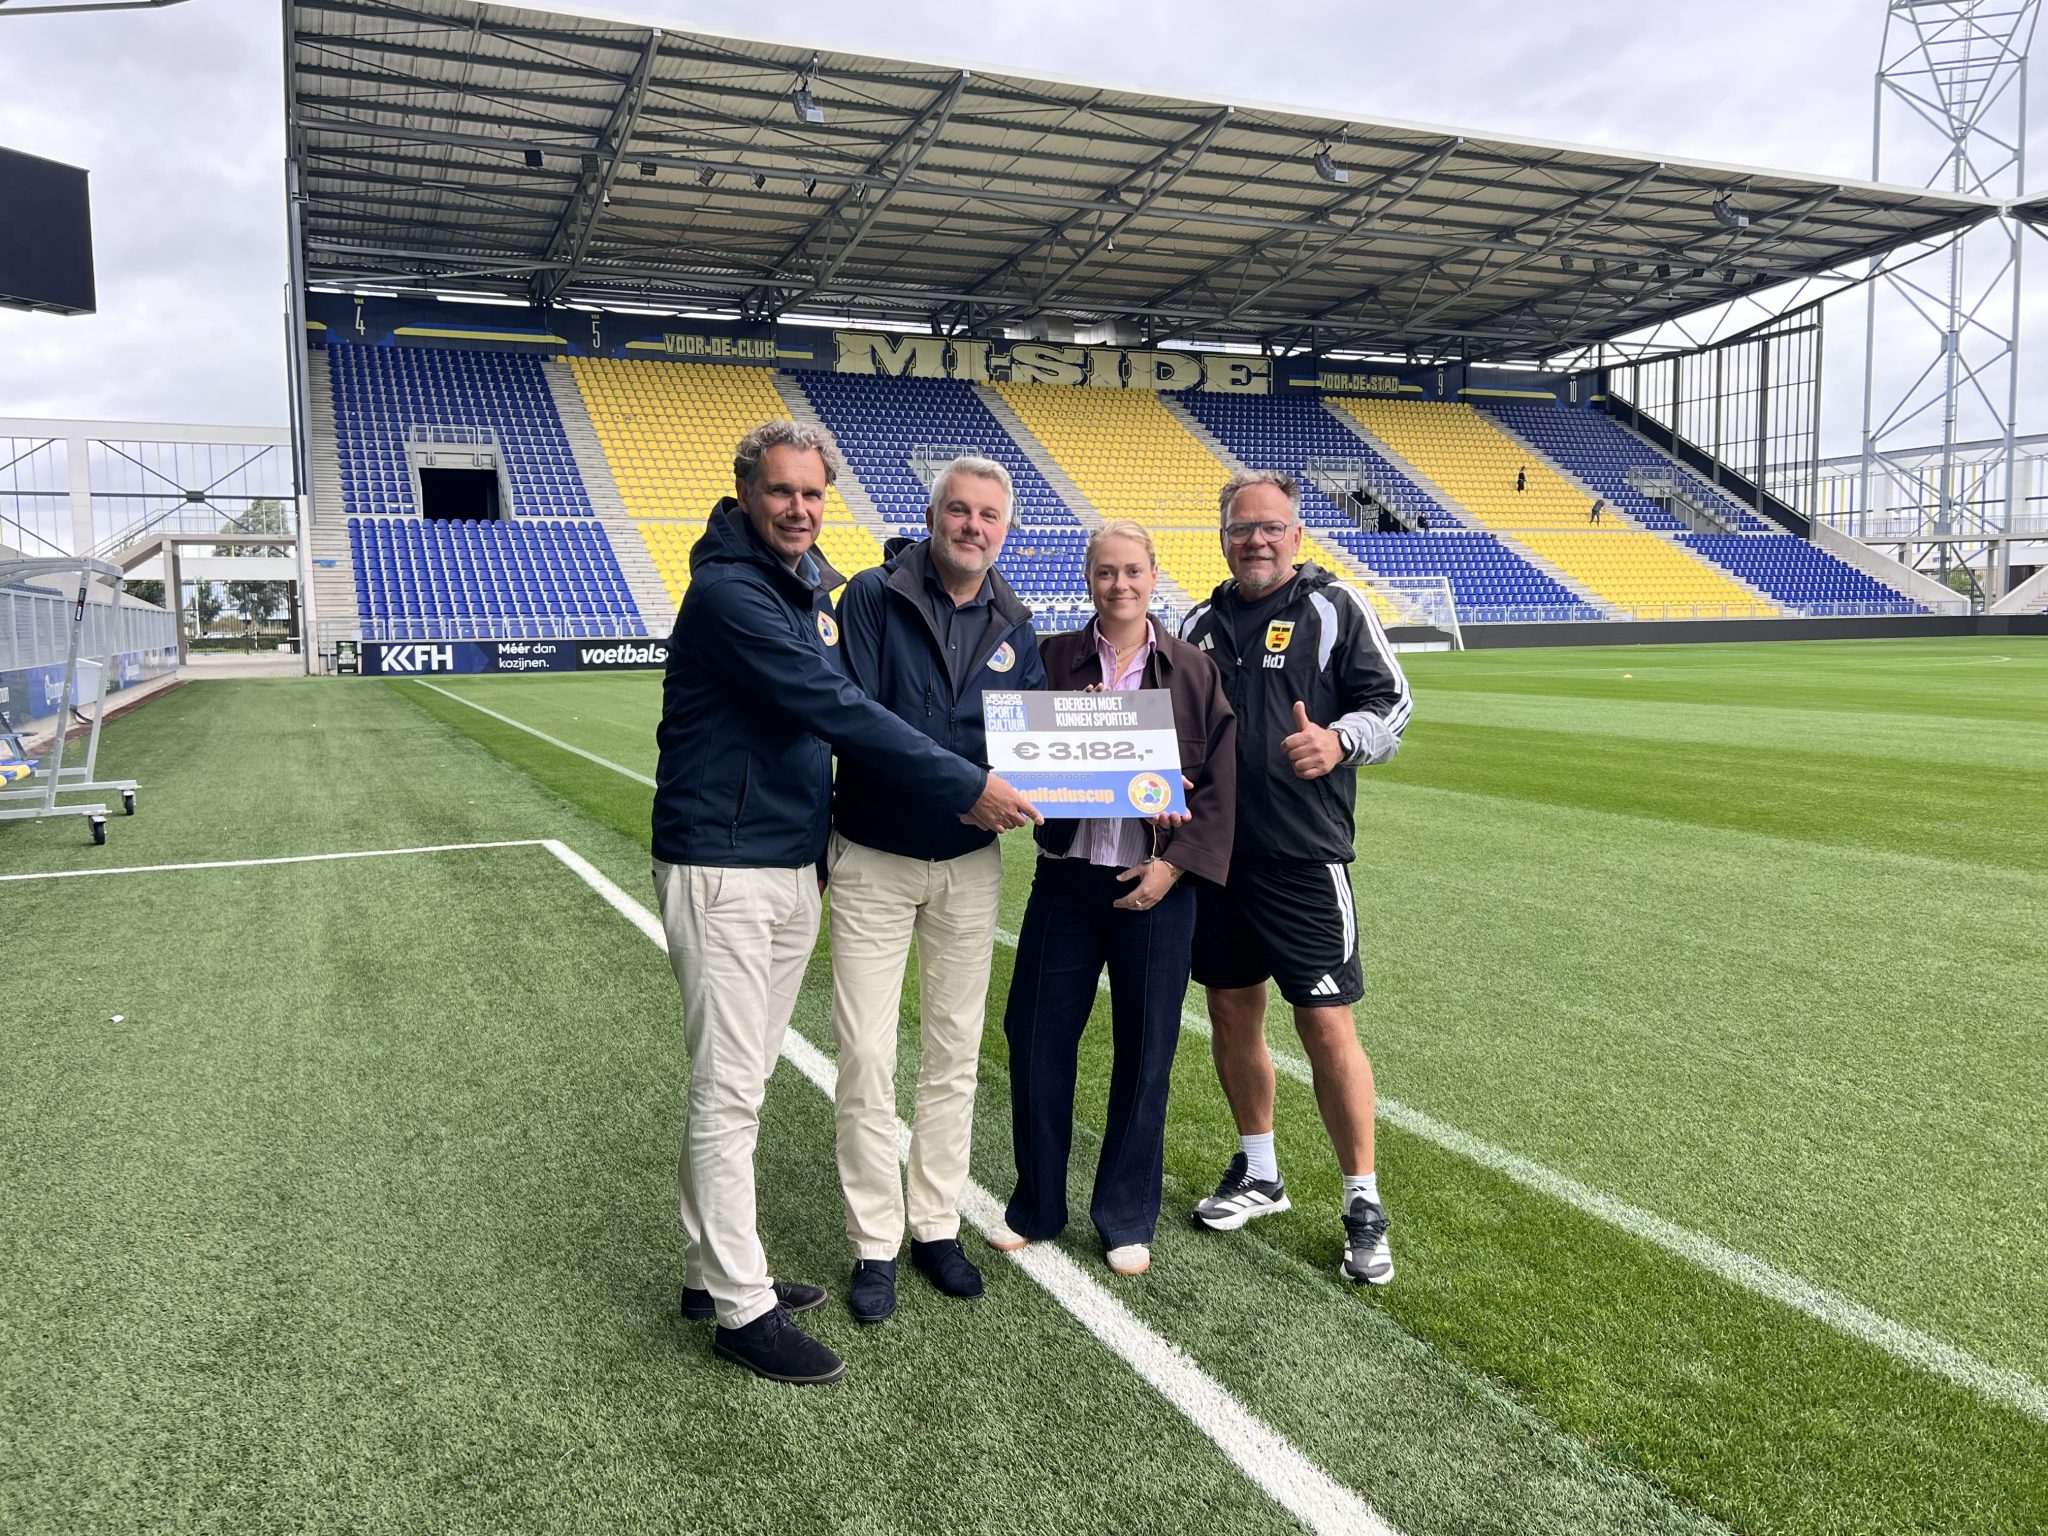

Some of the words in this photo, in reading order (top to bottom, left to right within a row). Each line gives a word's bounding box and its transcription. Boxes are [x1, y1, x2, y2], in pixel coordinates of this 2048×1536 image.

[356, 306, 365, 335] 4
[592, 321, 600, 348] 5
[833, 331, 1273, 395] MI-SIDE
[1438, 374, 1443, 395] 9
[1569, 381, 1576, 402] 10
[498, 643, 530, 654] Méér
[533, 643, 556, 654] dan
[581, 643, 669, 664] voetbals
[499, 658, 550, 670] kozijnen.
[987, 705, 1014, 718] SPORT
[1016, 705, 1024, 718] &
[1053, 697, 1097, 711] IEDEREEN
[1097, 696, 1122, 711] MOET
[988, 719, 1026, 731] CULTUUR
[1055, 713, 1093, 726] KUNNEN
[1093, 712, 1138, 726] SPORTEN!
[1012, 742, 1040, 760] €
[1048, 741, 1153, 761] 3.182,-
[1012, 787, 1114, 804] onifatiuscup
